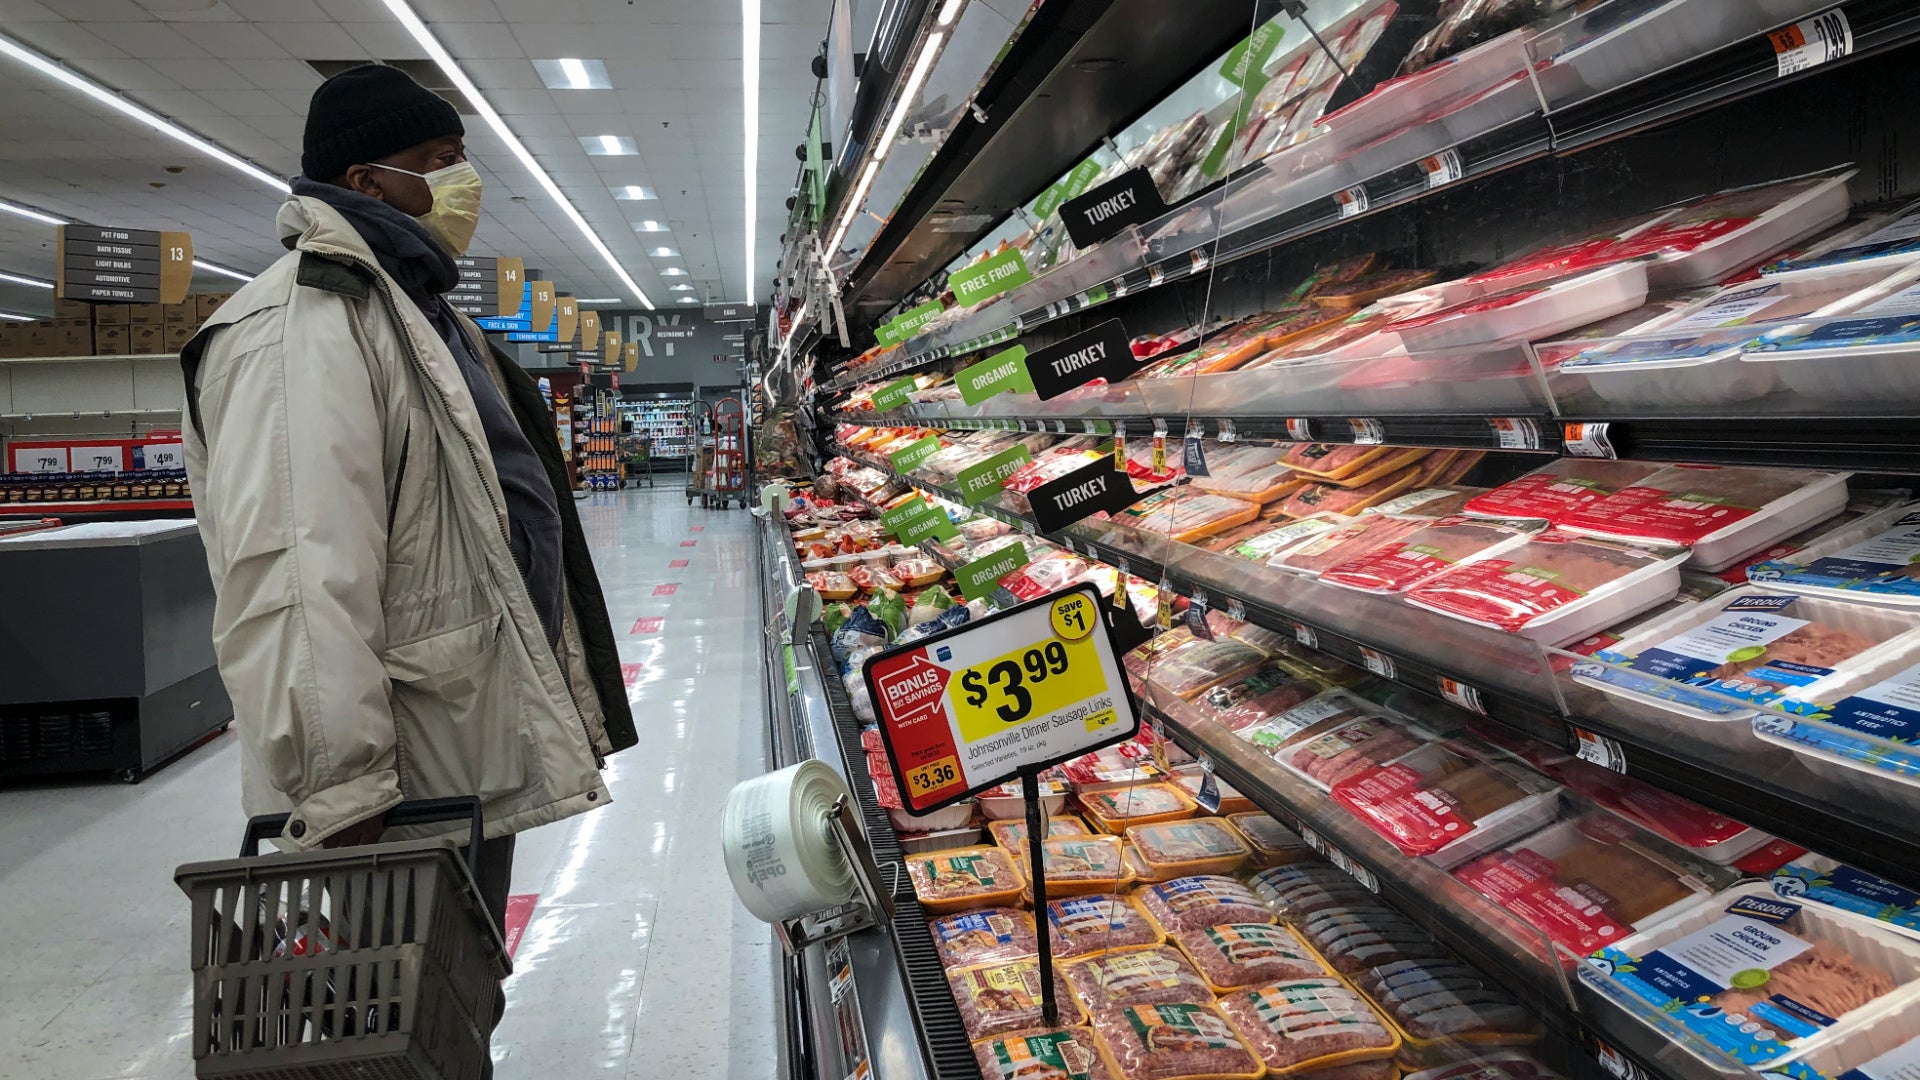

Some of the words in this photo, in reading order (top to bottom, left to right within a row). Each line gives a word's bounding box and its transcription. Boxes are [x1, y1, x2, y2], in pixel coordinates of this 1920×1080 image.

[1083, 187, 1137, 226] TURKEY
[97, 245, 111, 253] BATH
[113, 247, 132, 255] TISSUE
[170, 247, 183, 261] 13
[95, 260, 111, 268] LIGHT
[113, 261, 131, 269] BULBS
[95, 275, 130, 283] AUTOMOTIVE
[505, 270, 516, 281] 14
[960, 275, 985, 296] FREE
[987, 261, 1020, 286] FROM
[92, 289, 110, 297] PAPER
[112, 290, 134, 298] TOWELS
[538, 292, 549, 302] 15
[563, 306, 573, 316] 16
[901, 317, 919, 332] FREE
[920, 308, 940, 325] FROM
[488, 321, 500, 329] FACE
[586, 319, 594, 328] 17
[1051, 341, 1107, 378] TURKEY
[971, 361, 1018, 391] ORGANIC
[878, 393, 895, 407] FREE
[895, 383, 914, 400] FROM
[898, 453, 915, 468] FREE
[916, 443, 936, 460] FROM
[968, 471, 992, 492] FREE
[995, 456, 1026, 483] FROM
[1053, 475, 1107, 512] TURKEY
[887, 513, 904, 527] FREE
[904, 504, 924, 520] FROM
[908, 516, 940, 538] ORGANIC
[972, 557, 1017, 586] ORGANIC
[1058, 599, 1083, 615] save
[1734, 597, 1788, 608] PERDUE
[1064, 610, 1085, 631] $1
[1728, 622, 1766, 633] CHICKEN
[1740, 617, 1778, 627] GROUND
[887, 668, 939, 700] BONUS
[904, 682, 943, 704] SAVINGS
[898, 720, 913, 729] WITH
[912, 714, 928, 724] CARD
[968, 733, 1021, 760] Johnsonville
[1022, 721, 1051, 740] Dinner
[1051, 706, 1088, 729] Sausage
[1088, 697, 1113, 715] Links
[1852, 710, 1908, 727] ANTIBIOTICS
[971, 756, 995, 772] Selected
[913, 765, 954, 789] $3.36
[1851, 879, 1900, 896] ANTIBIOTICS
[1738, 898, 1793, 916] PERDUE
[1732, 931, 1771, 951] CHICKEN
[1743, 925, 1781, 945] GROUND
[1653, 967, 1690, 989] ANTIBIOTICS
